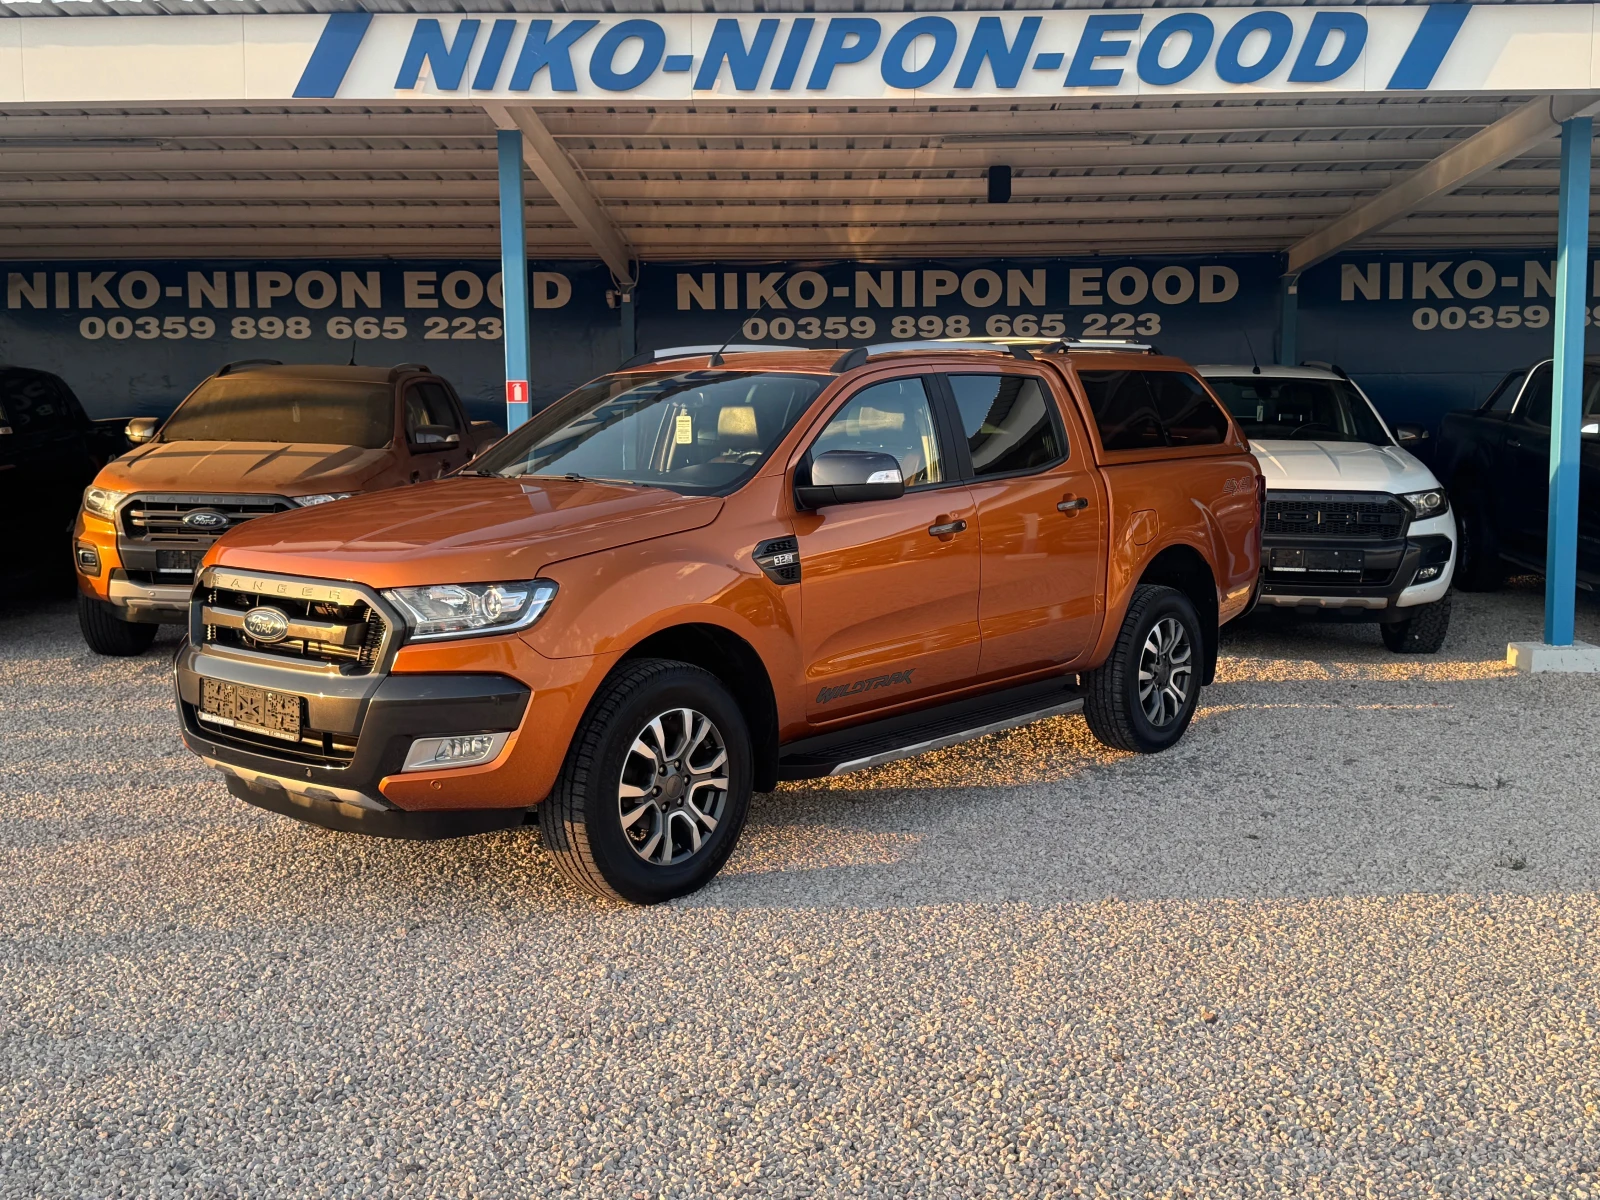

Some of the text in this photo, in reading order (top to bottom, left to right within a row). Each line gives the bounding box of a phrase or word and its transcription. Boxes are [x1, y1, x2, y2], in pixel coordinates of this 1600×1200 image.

[394, 12, 1369, 92] NIKO-NIPON-EOOD
[7, 271, 382, 309] NIKO-NIPON
[676, 266, 1239, 310] NIKO-NIPON EOOD
[80, 316, 503, 339] 00359 898 665 223
[742, 313, 1162, 340] 00359 898 665 223
[1412, 305, 1550, 331] 00359
[193, 515, 217, 525] Ford
[211, 572, 342, 600] RANGER
[249, 614, 275, 635] Ford
[816, 668, 917, 704] WILDTRAK
